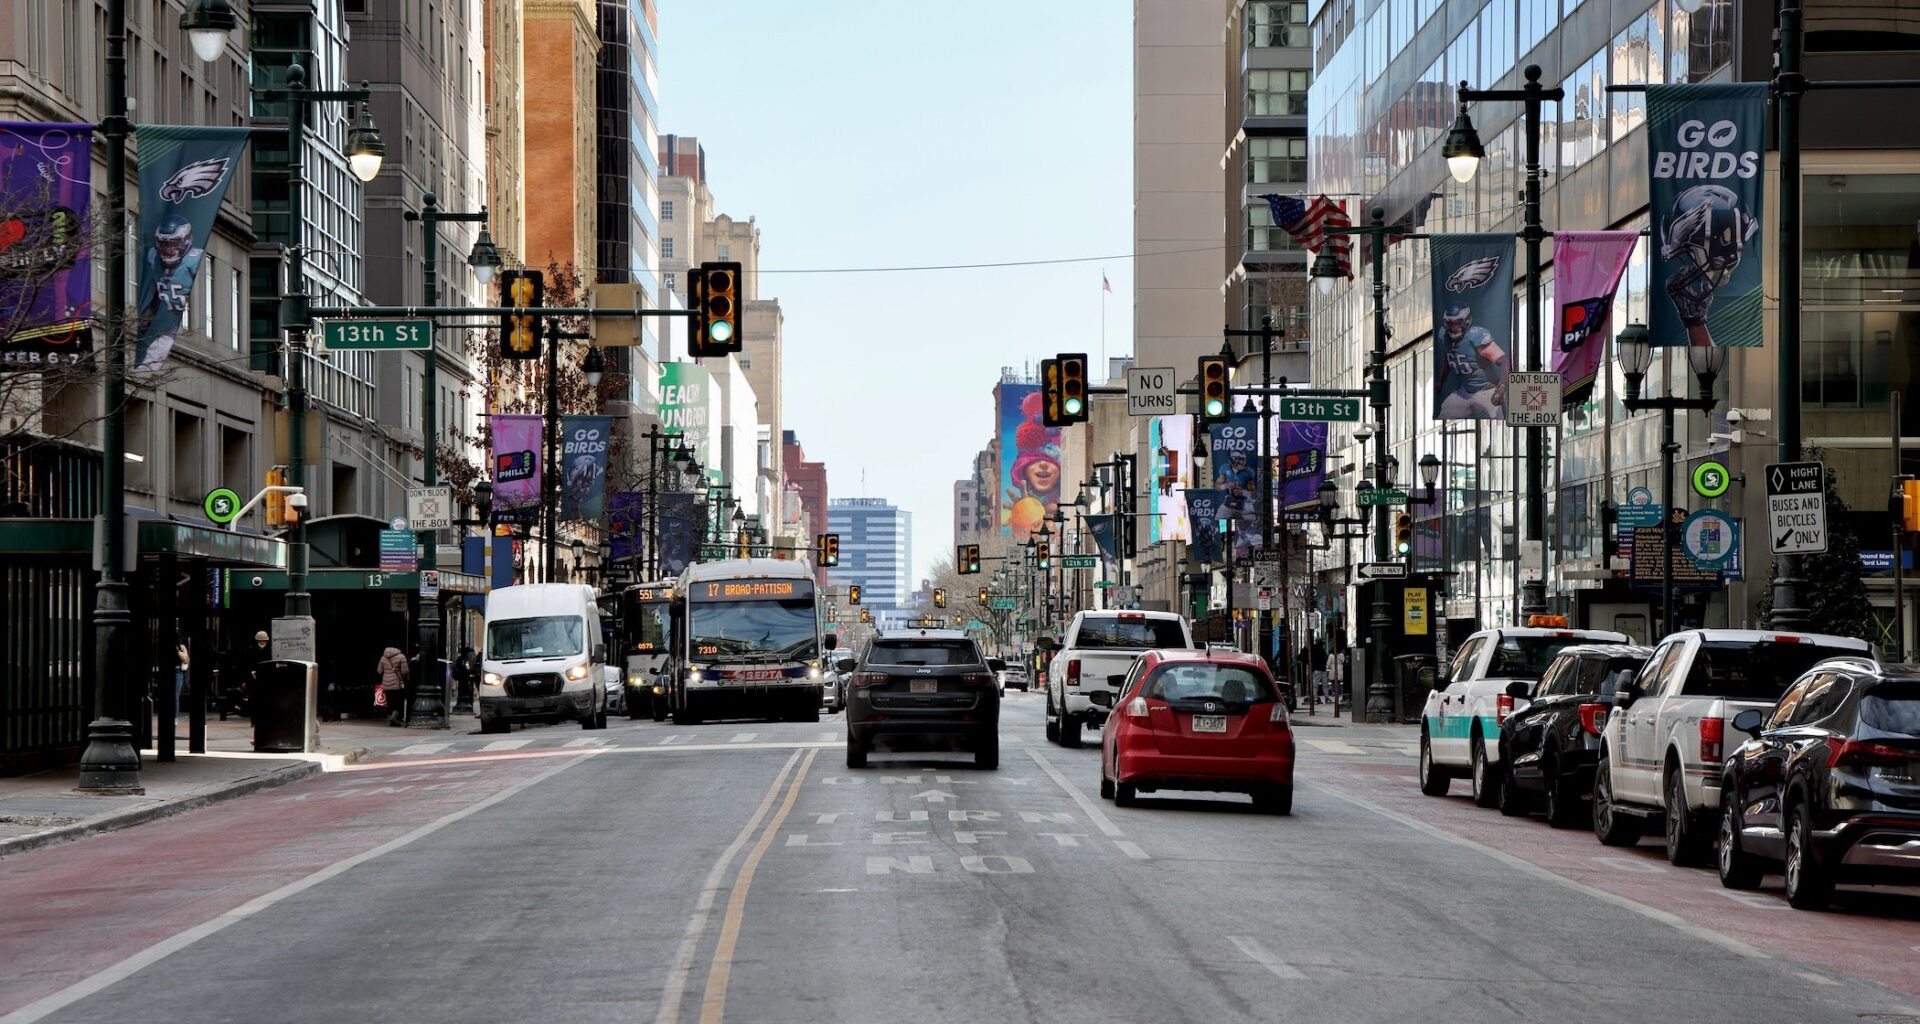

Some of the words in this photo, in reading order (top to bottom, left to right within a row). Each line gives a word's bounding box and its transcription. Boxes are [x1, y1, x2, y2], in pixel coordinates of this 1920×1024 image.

[1677, 119, 1737, 148] GO
[1653, 150, 1759, 179] BIRDS
[156, 282, 187, 311] 65
[337, 325, 385, 342] 13th
[396, 325, 419, 342] St
[1446, 352, 1473, 375] 65
[1140, 375, 1163, 389] NO
[1534, 374, 1559, 384] BLOCK
[1130, 395, 1173, 408] TURNS
[1289, 402, 1325, 416] 13th
[1332, 402, 1351, 416] St
[1511, 413, 1531, 423] THE
[1536, 412, 1557, 423] BOX
[574, 428, 600, 442] GO
[1221, 426, 1247, 438] GO
[564, 441, 607, 454] BIRDS
[1213, 439, 1256, 451] BIRDS
[499, 467, 530, 479] PHILLY
[1285, 464, 1317, 478] PHILLY
[1790, 467, 1819, 478] RIGHT
[1791, 479, 1817, 491] LANE
[428, 489, 448, 497] BLOCK
[1193, 498, 1211, 508] GO
[1386, 496, 1406, 504] STREET
[1772, 498, 1799, 512] BUSES
[1801, 497, 1820, 511] AND
[411, 520, 428, 529] THE
[431, 519, 448, 528] BOX
[1777, 513, 1817, 528] BICYCLES
[1794, 529, 1821, 545] ONLY
[1064, 559, 1081, 567] 12th
[1083, 559, 1093, 567] St
[639, 589, 654, 600] 551
[707, 584, 719, 597] 17
[724, 582, 793, 596] BROAD-PATTISON
[697, 646, 718, 655] 7310
[747, 670, 783, 680] SEPTA
[821, 775, 1033, 786] ONLY
[808, 809, 1077, 825] TURN
[785, 831, 1089, 847] LEFT
[865, 855, 1036, 875] NO
